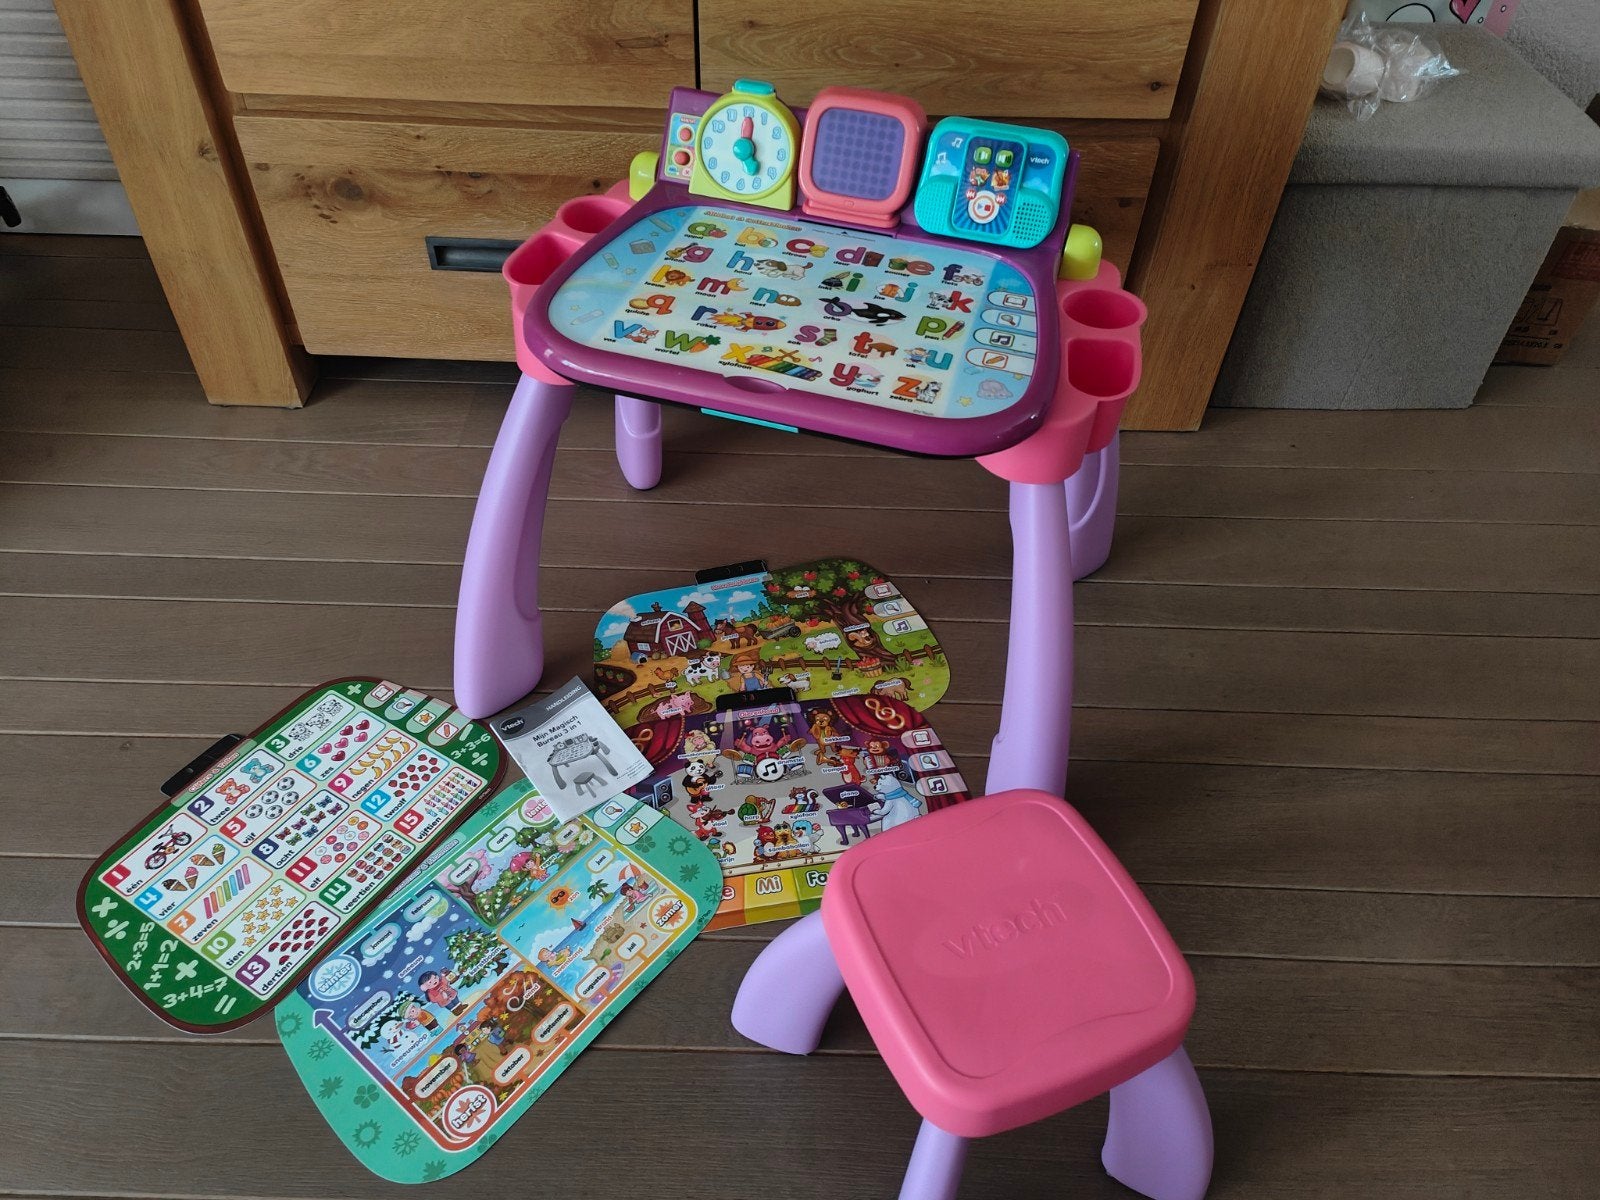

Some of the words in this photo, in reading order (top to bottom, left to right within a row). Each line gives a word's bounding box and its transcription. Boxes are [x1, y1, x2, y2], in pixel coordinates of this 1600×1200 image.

[727, 108, 738, 122] 11
[760, 112, 768, 125] 1
[712, 120, 726, 133] 10
[772, 126, 782, 140] 2
[704, 137, 713, 149] 9
[708, 157, 717, 169] 8
[776, 148, 786, 161] 3
[1030, 156, 1050, 165] vtech
[752, 177, 761, 189] 5
[767, 167, 777, 180] 4
[736, 178, 745, 190] 6
[684, 246, 714, 263] g
[726, 250, 754, 271] h
[835, 246, 866, 265] d
[906, 260, 935, 276] e
[942, 263, 963, 282] f
[697, 277, 731, 295] m
[845, 272, 864, 292] i
[895, 281, 918, 302] j
[646, 294, 676, 316] q
[752, 287, 780, 304] n
[949, 290, 974, 313] k
[690, 305, 718, 321] r
[614, 319, 642, 339] v
[794, 324, 821, 343] s
[915, 315, 947, 336] p
[665, 330, 702, 353] w
[853, 331, 874, 354] t
[720, 343, 754, 364] x
[925, 349, 953, 371] u
[718, 359, 752, 371] xylofoon
[829, 362, 860, 387] y
[846, 386, 879, 396] yoghurt
[892, 376, 921, 398] z
[545, 685, 582, 711] HANDLEIDING
[501, 717, 524, 732] vtech
[532, 730, 549, 743] Mijn
[548, 714, 579, 734] Magisch
[270, 737, 287, 749] 3
[536, 731, 563, 748] Bureau
[562, 727, 570, 736] 3
[568, 723, 578, 732] in
[288, 745, 304, 760] drie
[450, 733, 491, 760] 3+3=6
[302, 757, 317, 769] 6
[320, 766, 335, 779] zes
[334, 777, 348, 789] 9
[351, 778, 375, 800] negen
[364, 793, 387, 810] 12
[840, 790, 859, 798] piano
[194, 800, 211, 813] 2
[210, 806, 231, 823] twee
[383, 797, 407, 819] twaalf
[226, 820, 242, 834] 5
[399, 813, 419, 831] 15
[744, 814, 760, 822] harp
[417, 816, 442, 841] vijftien
[242, 831, 257, 846] vijf
[258, 842, 274, 855] 8
[276, 849, 296, 867] acht
[111, 870, 124, 880] 1
[291, 860, 312, 877] 11
[309, 876, 322, 889] elf
[322, 882, 347, 902] 14
[756, 875, 782, 894] Mi
[807, 871, 828, 887] Fa
[139, 891, 158, 905] 4
[343, 881, 376, 911] veertien
[411, 894, 435, 915] februari
[158, 901, 176, 917] vier
[656, 900, 683, 927] zomer
[174, 915, 189, 929] 7
[191, 918, 219, 942] zeven
[942, 898, 1068, 959] vtech
[127, 921, 156, 972] 2+3=5
[206, 936, 229, 955] 10
[370, 930, 393, 951] januari
[143, 939, 179, 991] 1+1=2
[225, 950, 245, 967] tien
[240, 961, 265, 981] 13
[262, 961, 293, 992] dertien
[318, 962, 353, 994] winter
[162, 976, 228, 1009] 3+4=7
[582, 971, 607, 995] augustus
[353, 996, 384, 1024] december
[540, 1007, 570, 1039] september
[391, 1033, 428, 1067] sneeuwpop
[501, 1053, 524, 1078] oktober
[421, 1062, 452, 1093] november
[451, 1094, 488, 1130] herfst
